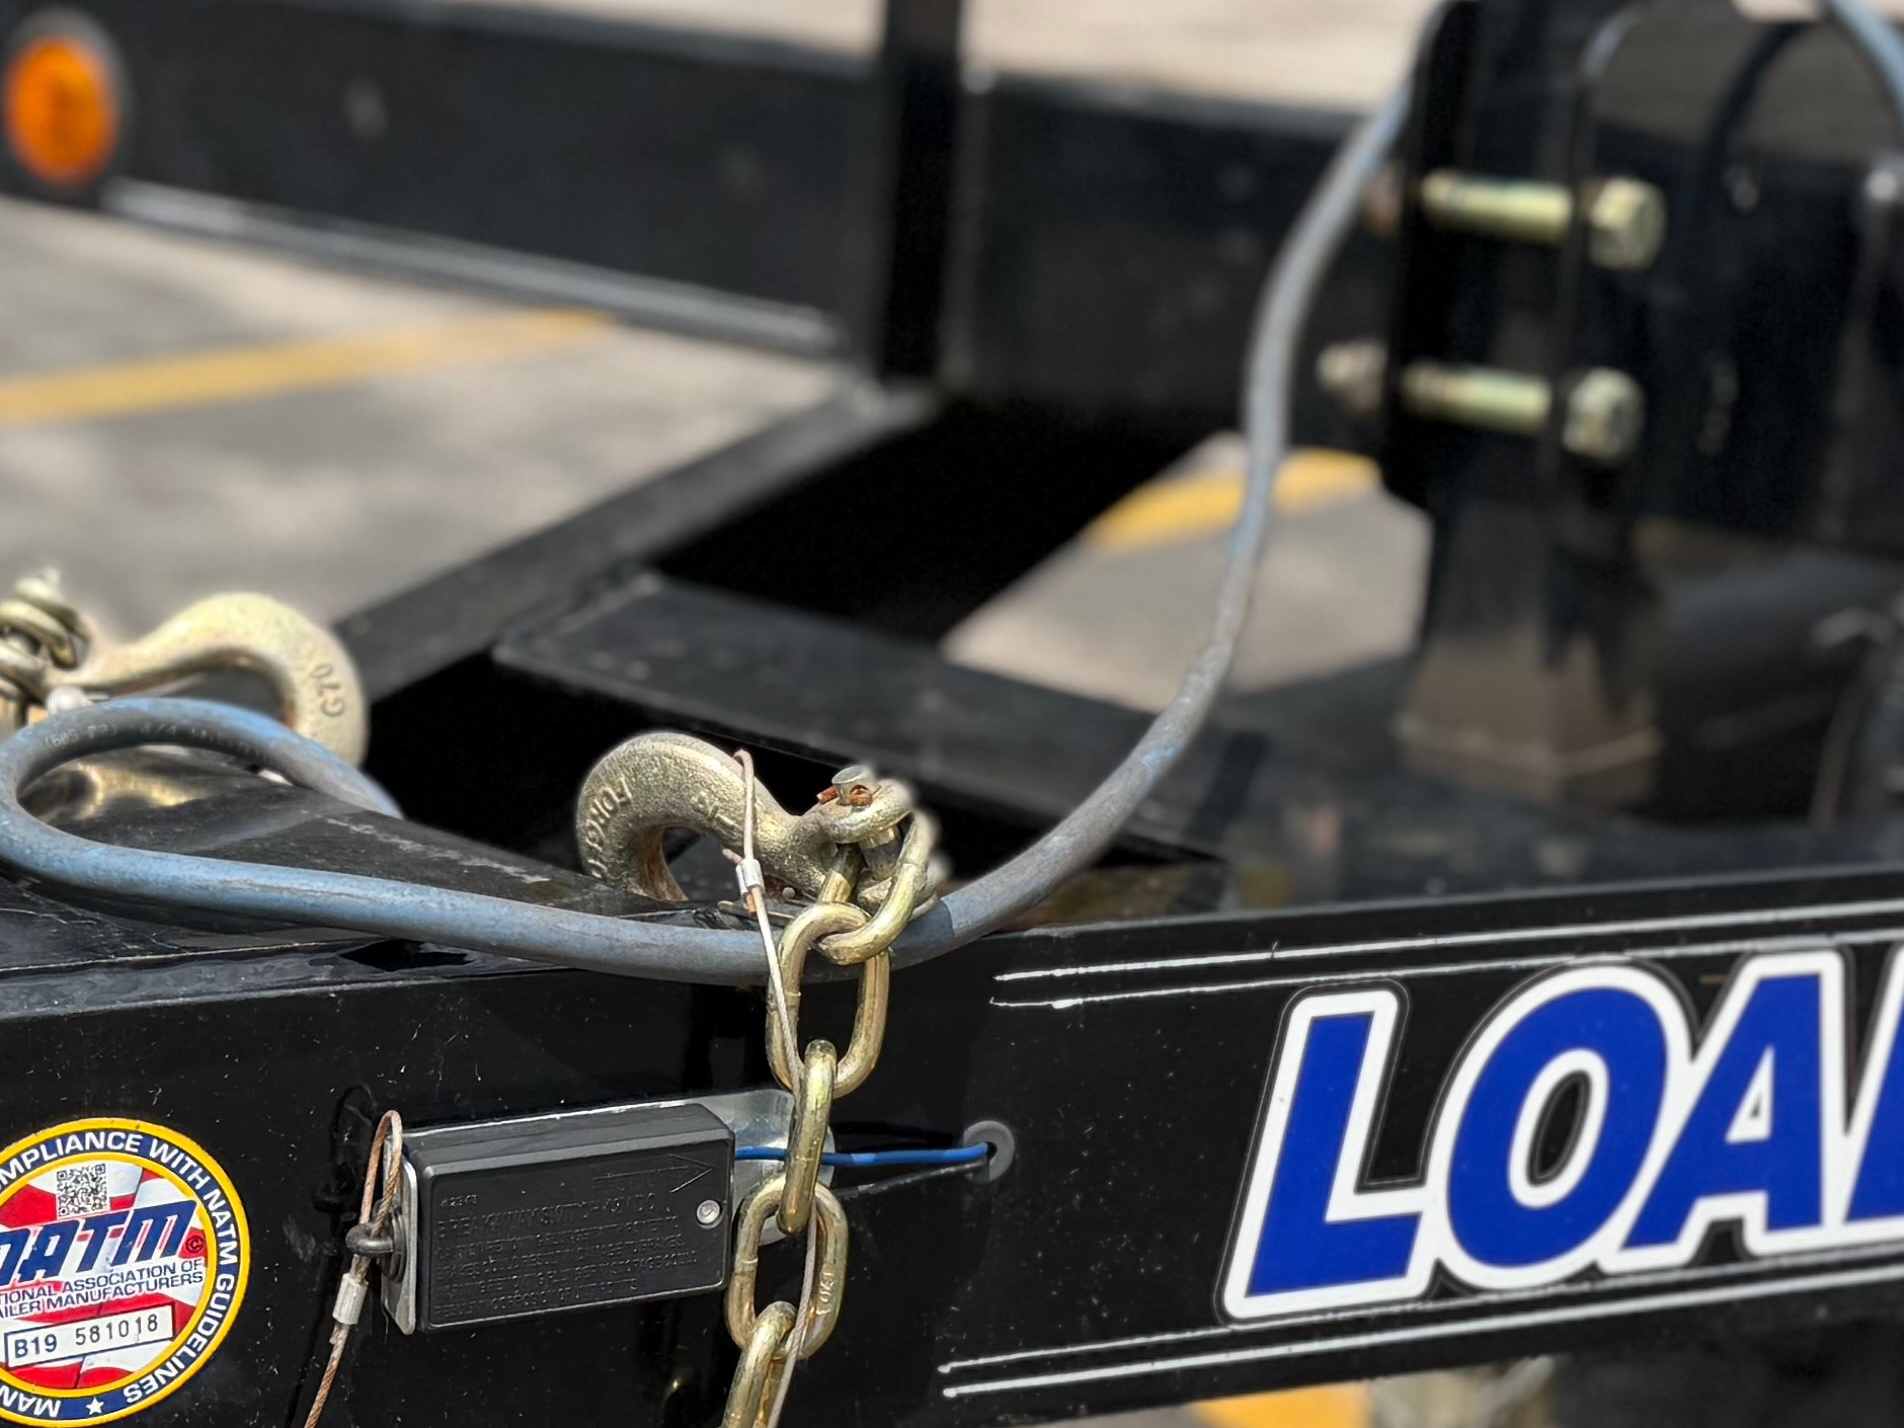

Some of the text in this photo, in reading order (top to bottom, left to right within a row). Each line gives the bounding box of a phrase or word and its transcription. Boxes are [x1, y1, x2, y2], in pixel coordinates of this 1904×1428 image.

[150, 1139, 212, 1190] WITH
[203, 1190, 238, 1266] NATM
[46, 1271, 203, 1311] MANUFACTURERS
[62, 1263, 178, 1292] ASSOCIATION
[181, 1258, 202, 1273] OF
[13, 1314, 159, 1360] B19 581018
[124, 1272, 235, 1404] GUIDELINES
